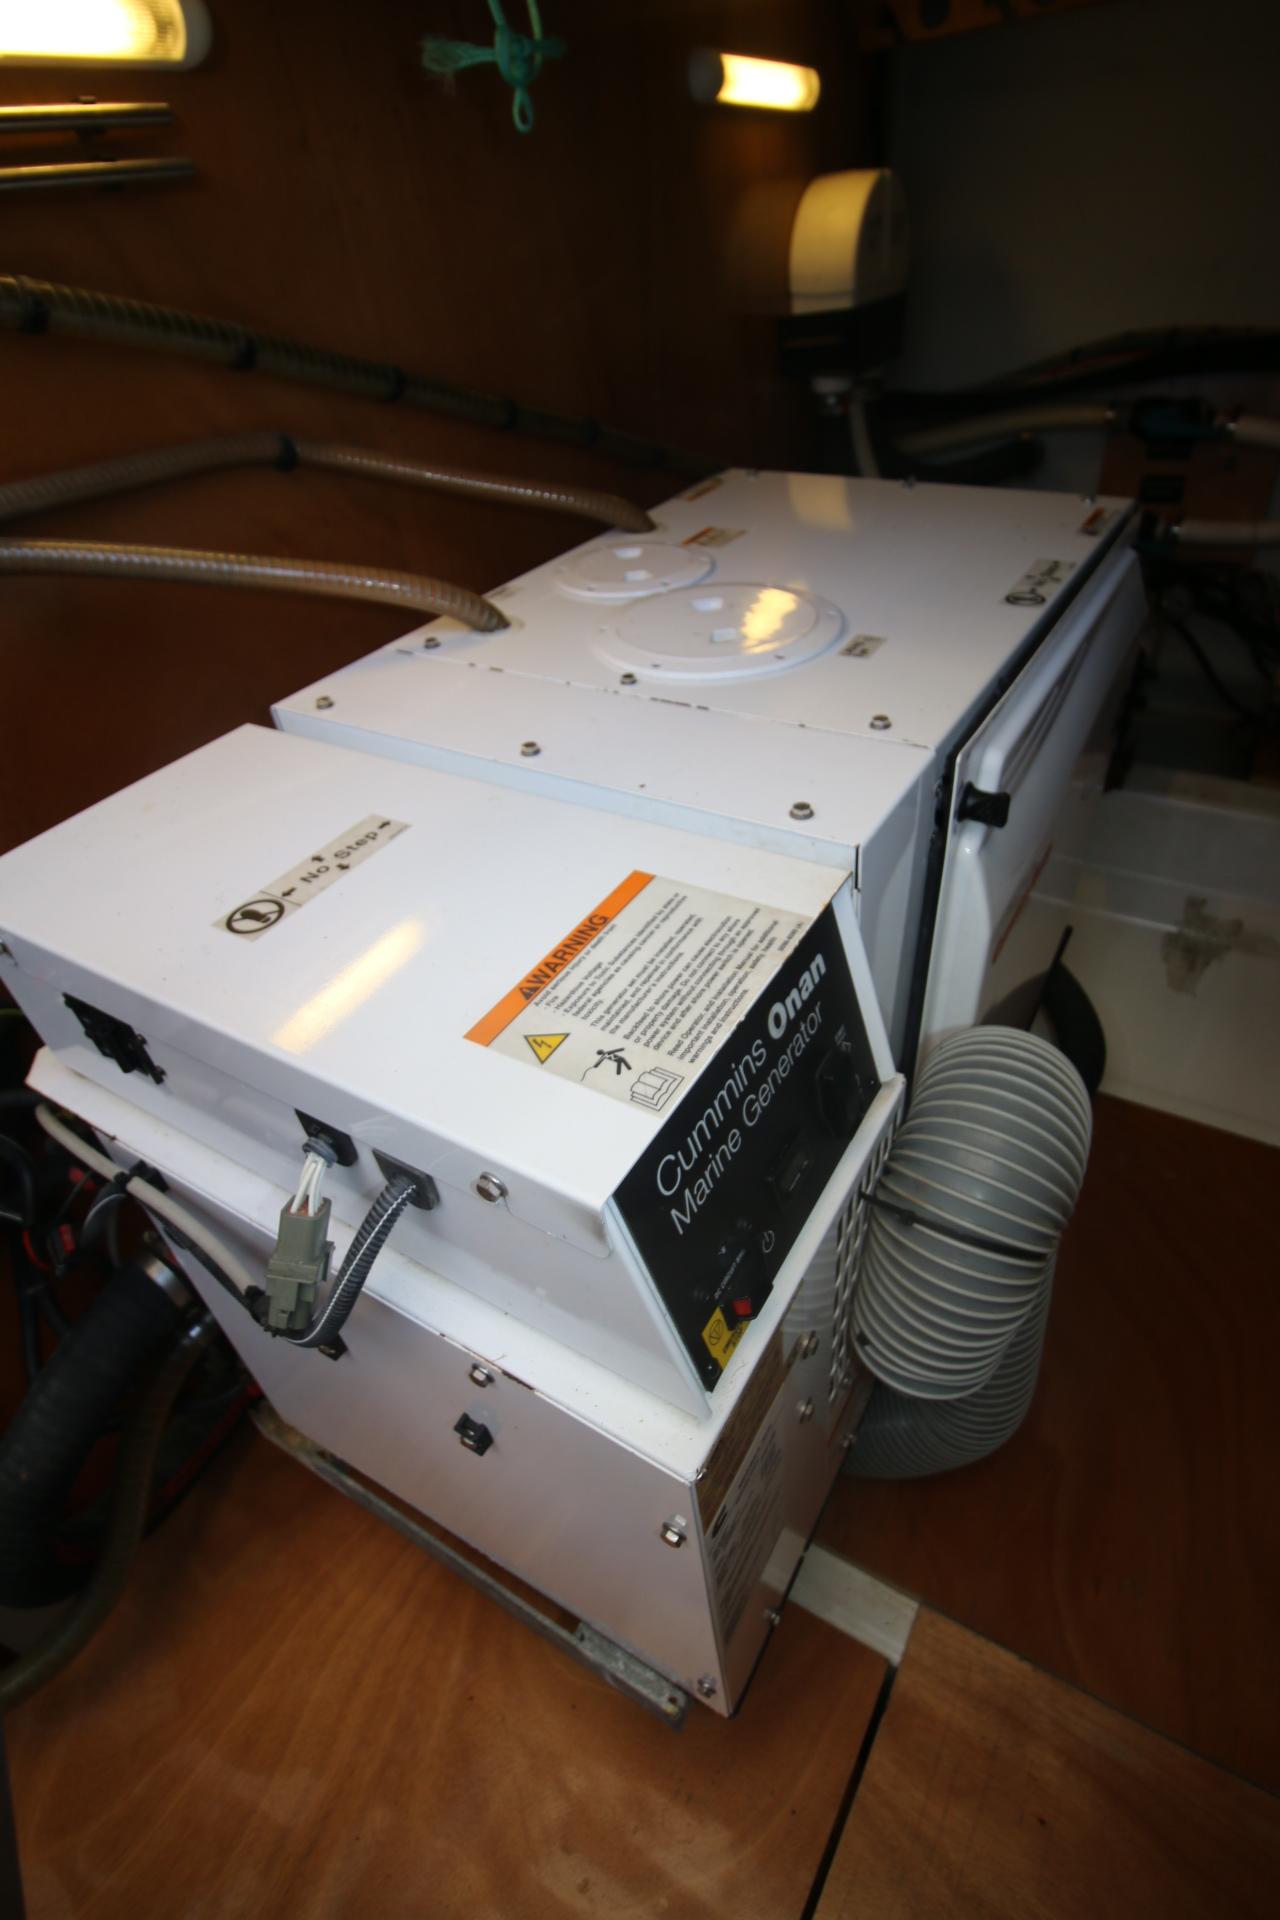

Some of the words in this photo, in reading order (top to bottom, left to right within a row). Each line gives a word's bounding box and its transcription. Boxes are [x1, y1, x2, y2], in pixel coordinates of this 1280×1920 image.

[300, 864, 330, 884] No
[334, 831, 378, 859] Step
[526, 914, 608, 984] WARNING
[656, 1038, 767, 1197] Cummins
[767, 952, 826, 1040] Onan
[670, 1131, 742, 1236] Marine
[742, 1003, 824, 1127] Generator
